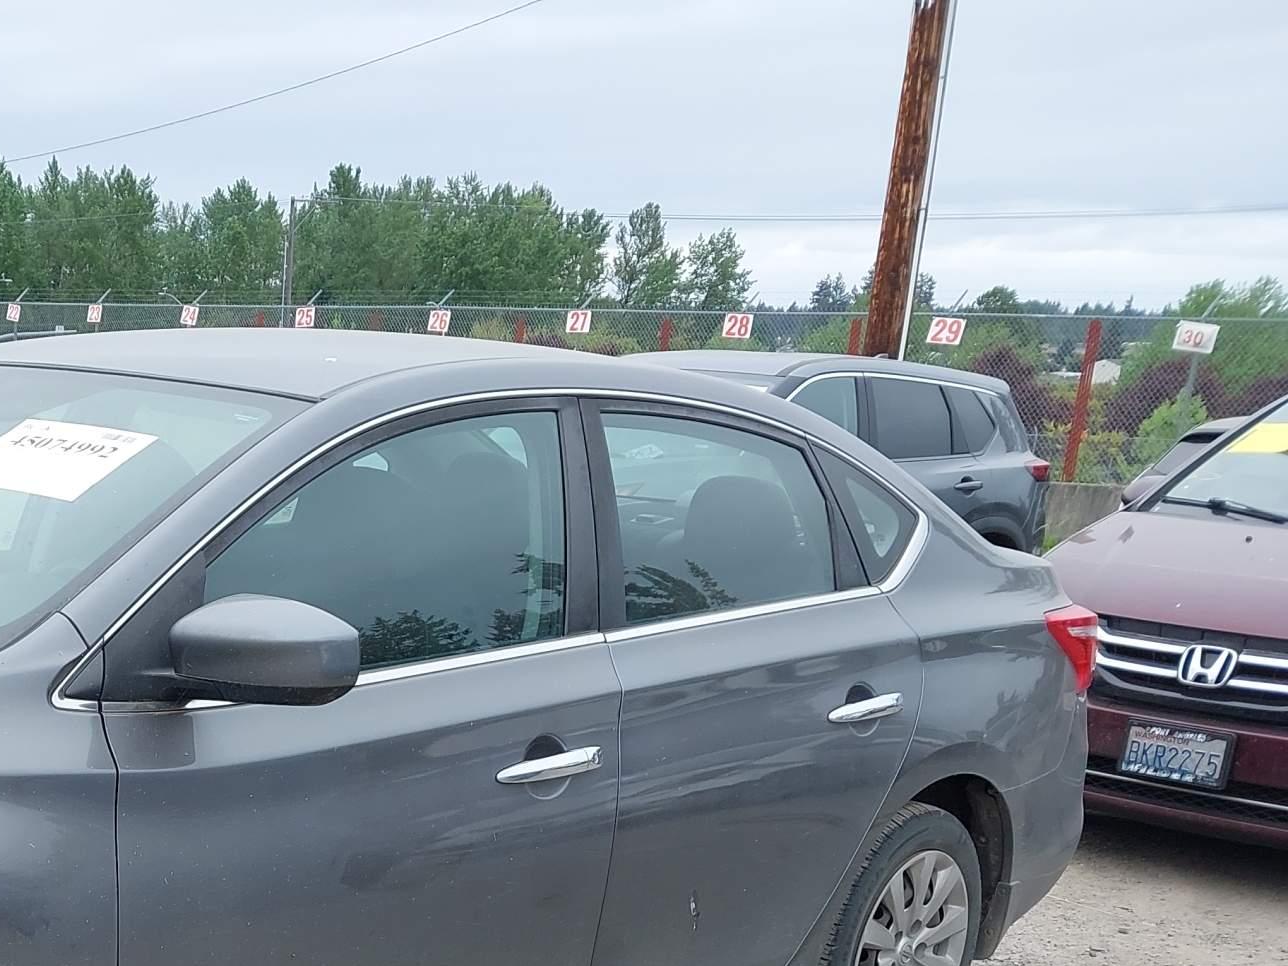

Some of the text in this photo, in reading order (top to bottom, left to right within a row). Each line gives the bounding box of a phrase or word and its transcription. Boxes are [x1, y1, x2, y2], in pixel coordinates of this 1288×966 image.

[8, 305, 19, 320] 22
[89, 305, 101, 321] 23
[181, 307, 196, 323] 24
[297, 307, 313, 326] 25
[430, 312, 448, 331] 26
[569, 311, 589, 331] 27
[725, 315, 750, 336] 28
[930, 319, 962, 343] 29
[1183, 329, 1204, 346] 30
[10, 434, 119, 459] 45074992
[1128, 740, 1221, 777] BKR2275
